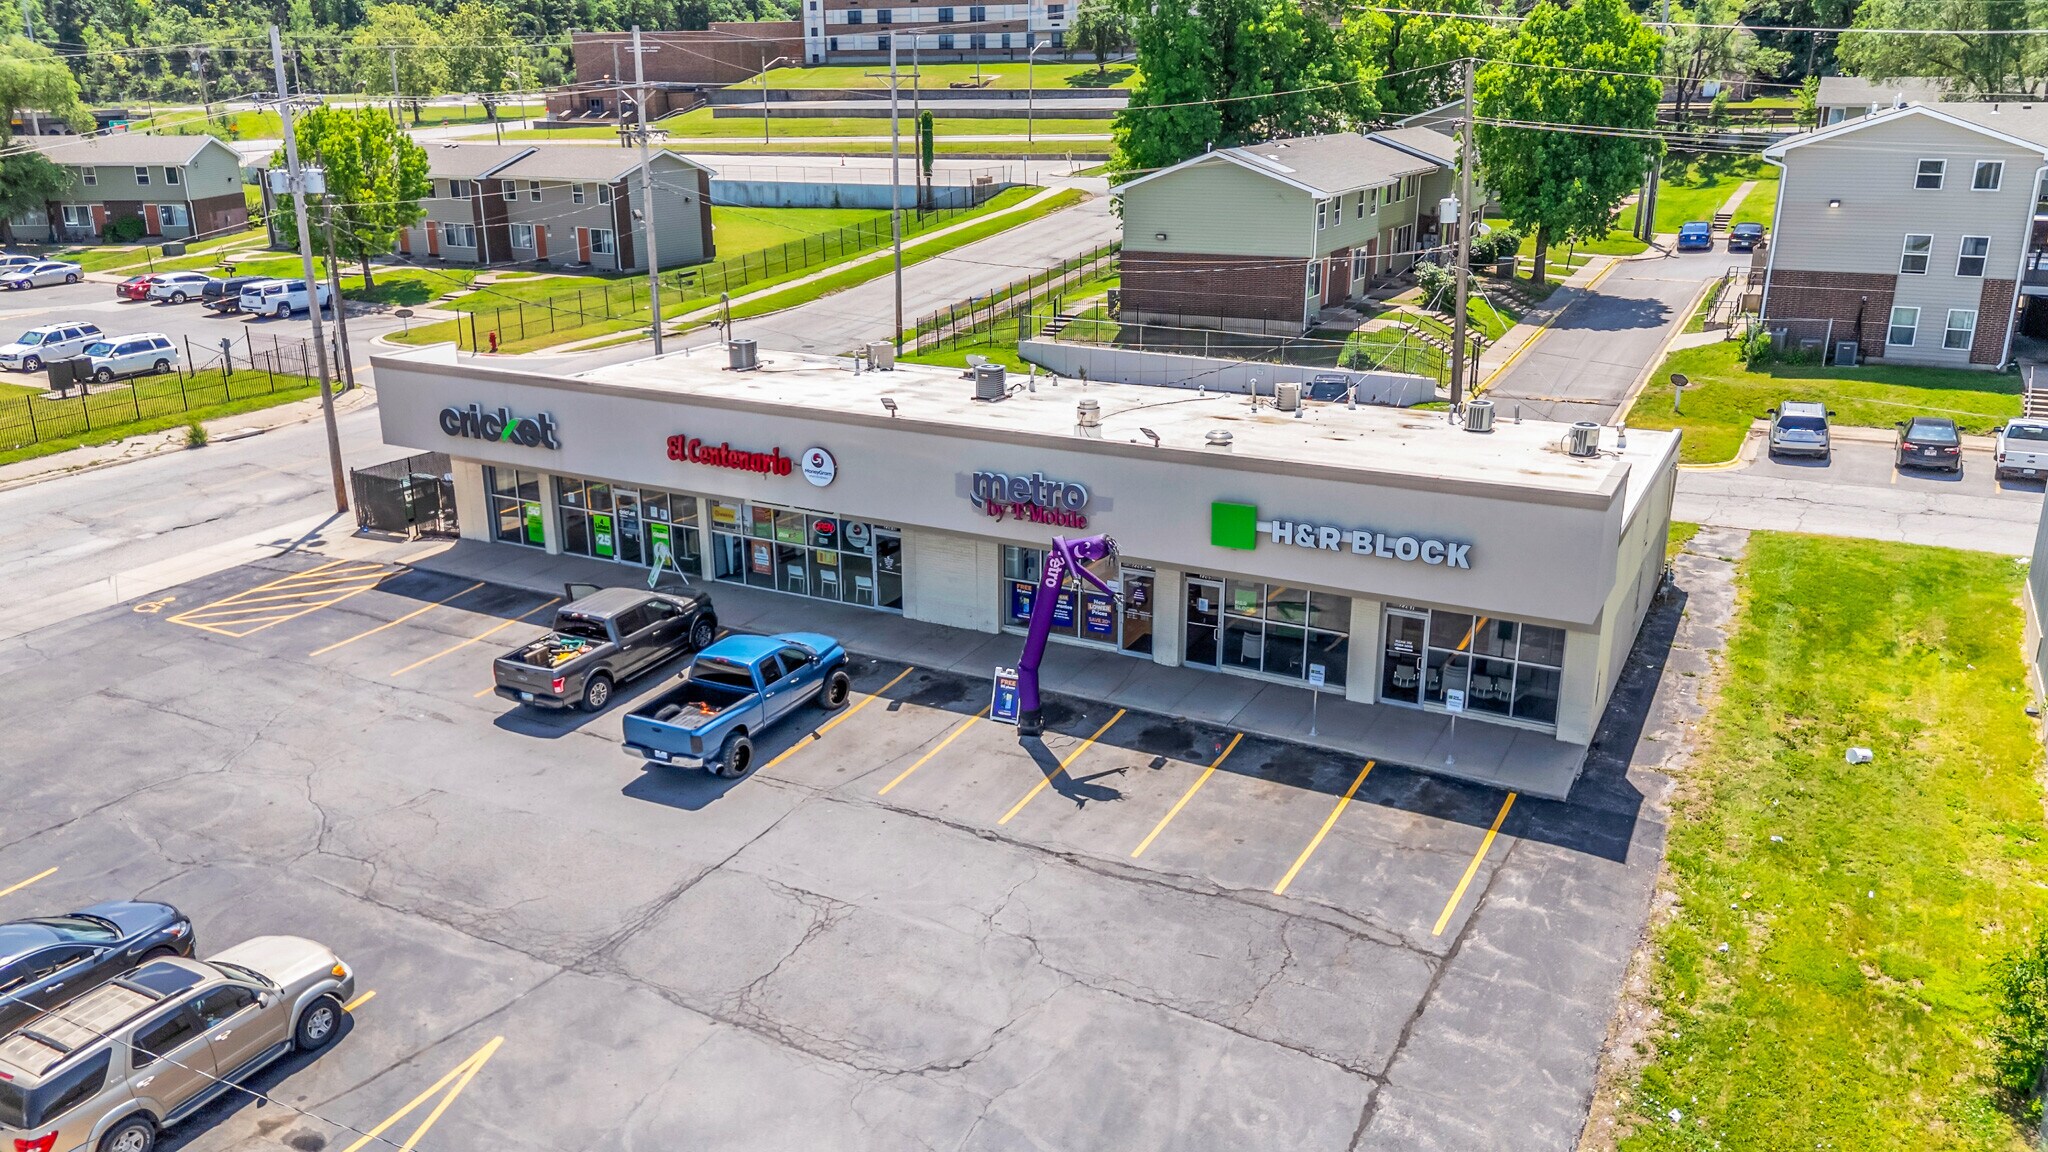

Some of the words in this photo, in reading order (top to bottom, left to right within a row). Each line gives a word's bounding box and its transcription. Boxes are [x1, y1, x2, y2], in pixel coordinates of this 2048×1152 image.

[439, 403, 559, 450] cricket
[667, 434, 686, 461] El
[688, 438, 792, 476] Centenario
[804, 468, 832, 476] MoneyGram
[969, 471, 1088, 511] metro
[986, 499, 1008, 522] by
[1271, 520, 1341, 552] H&R
[1351, 530, 1472, 569] BLOCK
[1000, 678, 1017, 686] FREE
